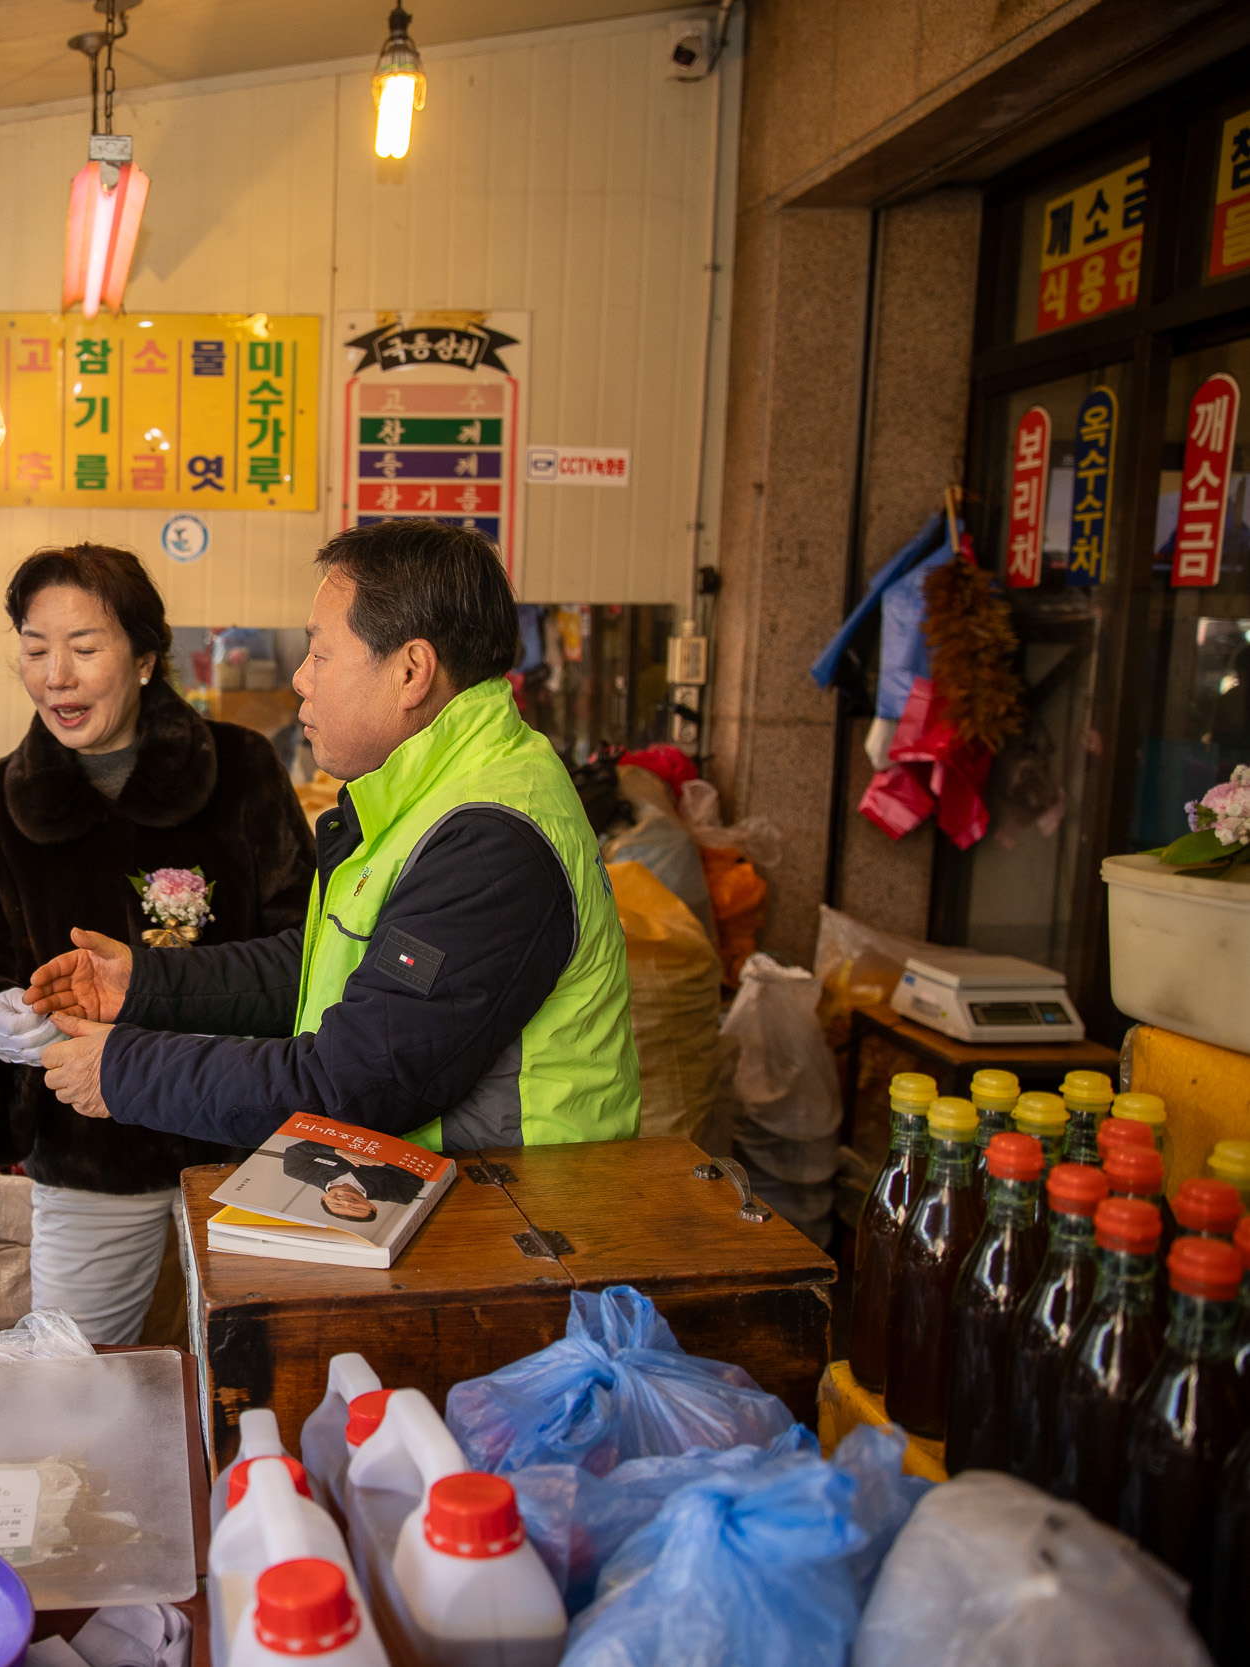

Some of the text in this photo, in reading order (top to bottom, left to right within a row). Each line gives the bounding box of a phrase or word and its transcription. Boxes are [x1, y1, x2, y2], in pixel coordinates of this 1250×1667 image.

[1042, 239, 1142, 321] 식용유
[16, 337, 53, 491] 고추
[74, 338, 113, 491] 참기름
[131, 338, 168, 492] 소금
[187, 340, 227, 492] 물엿
[247, 340, 285, 493] 미수가루
[1178, 394, 1230, 579] 깨소금
[1008, 425, 1043, 581] 보리차
[1070, 405, 1111, 579] 옥수수차
